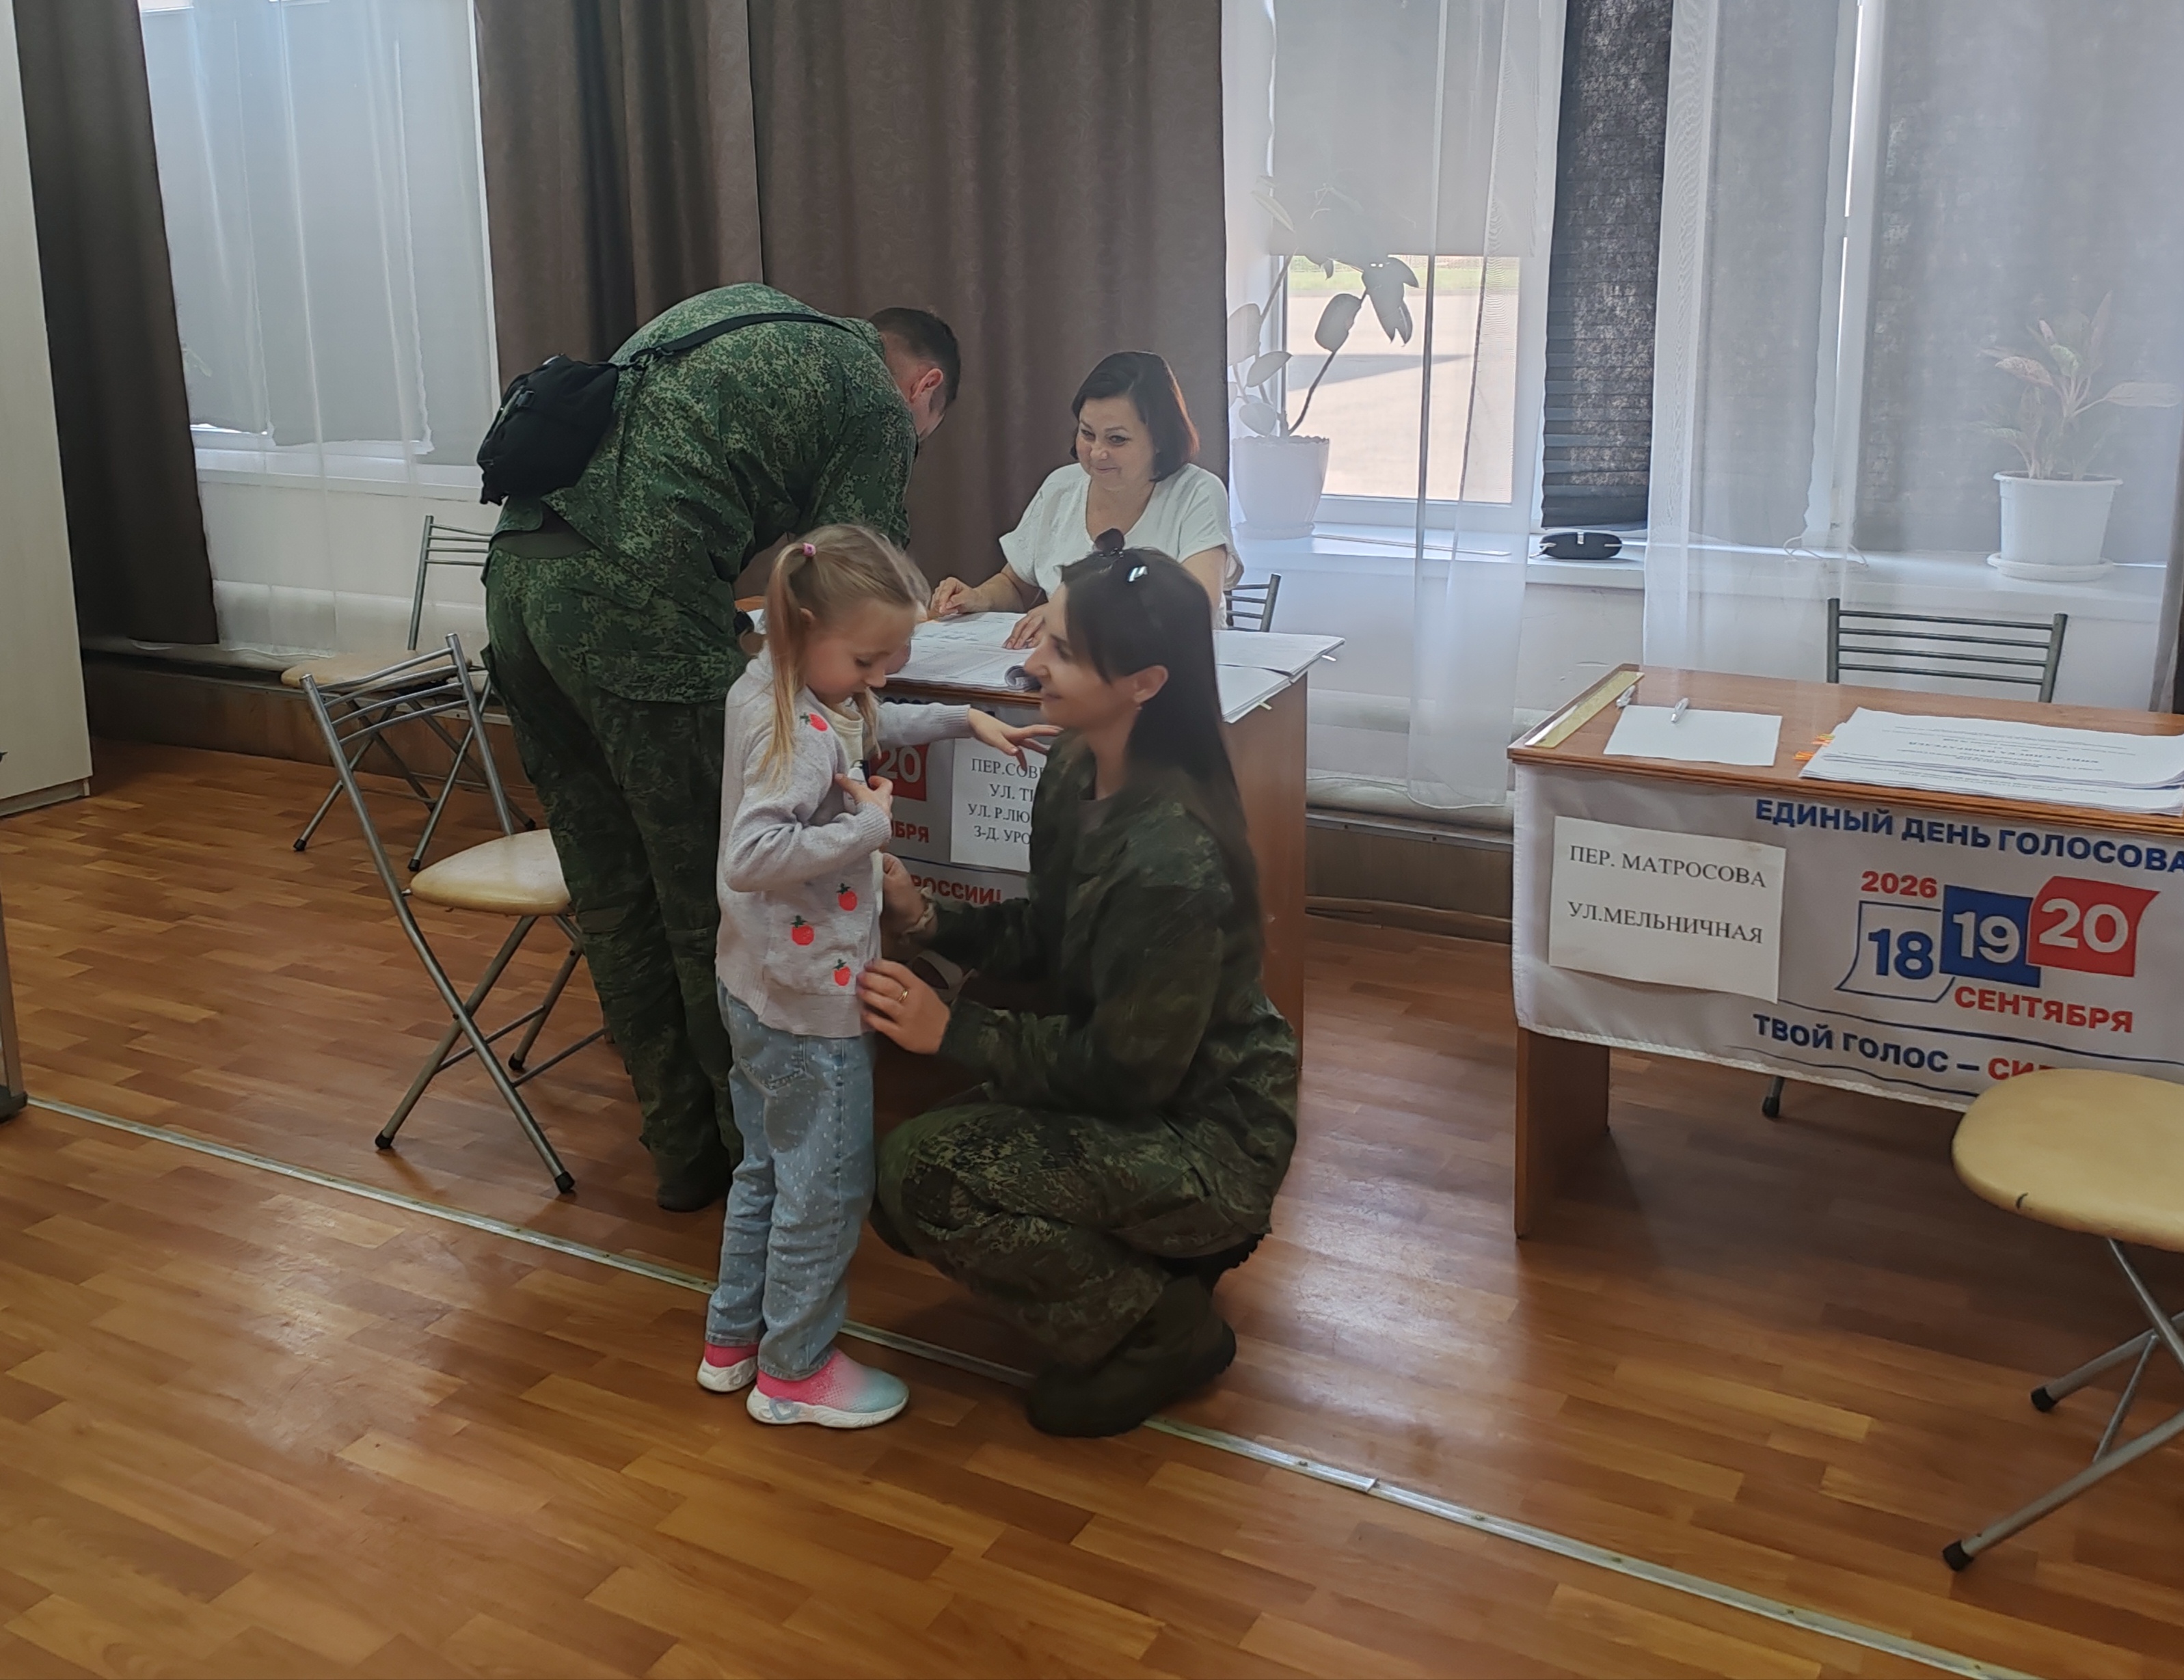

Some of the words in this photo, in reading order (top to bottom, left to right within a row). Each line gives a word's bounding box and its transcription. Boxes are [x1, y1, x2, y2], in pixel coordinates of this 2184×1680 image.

[876, 745, 921, 783] 20
[968, 803, 990, 818] УЛ.
[989, 783, 1015, 800] УЛ.
[1756, 798, 1893, 835] ЕДИНЫЙ
[1902, 817, 1991, 848] ДЕНЬ
[1570, 845, 1615, 867] ПЕР.
[1622, 853, 1766, 888] МАТРОСОВА
[1861, 871, 1938, 898] 2026
[1568, 901, 1763, 944] УЛ.МЕЛЬНИЧНАЯ
[1868, 928, 1933, 979] 18
[1952, 911, 2020, 964] 19
[2038, 898, 2129, 953] 20
[1954, 986, 2133, 1033] СЕНТЯБРЯ
[1753, 1014, 1833, 1051] ТВОЙ
[1842, 1032, 1948, 1072] ГОЛОС
[1988, 1057, 2057, 1081] СИ
